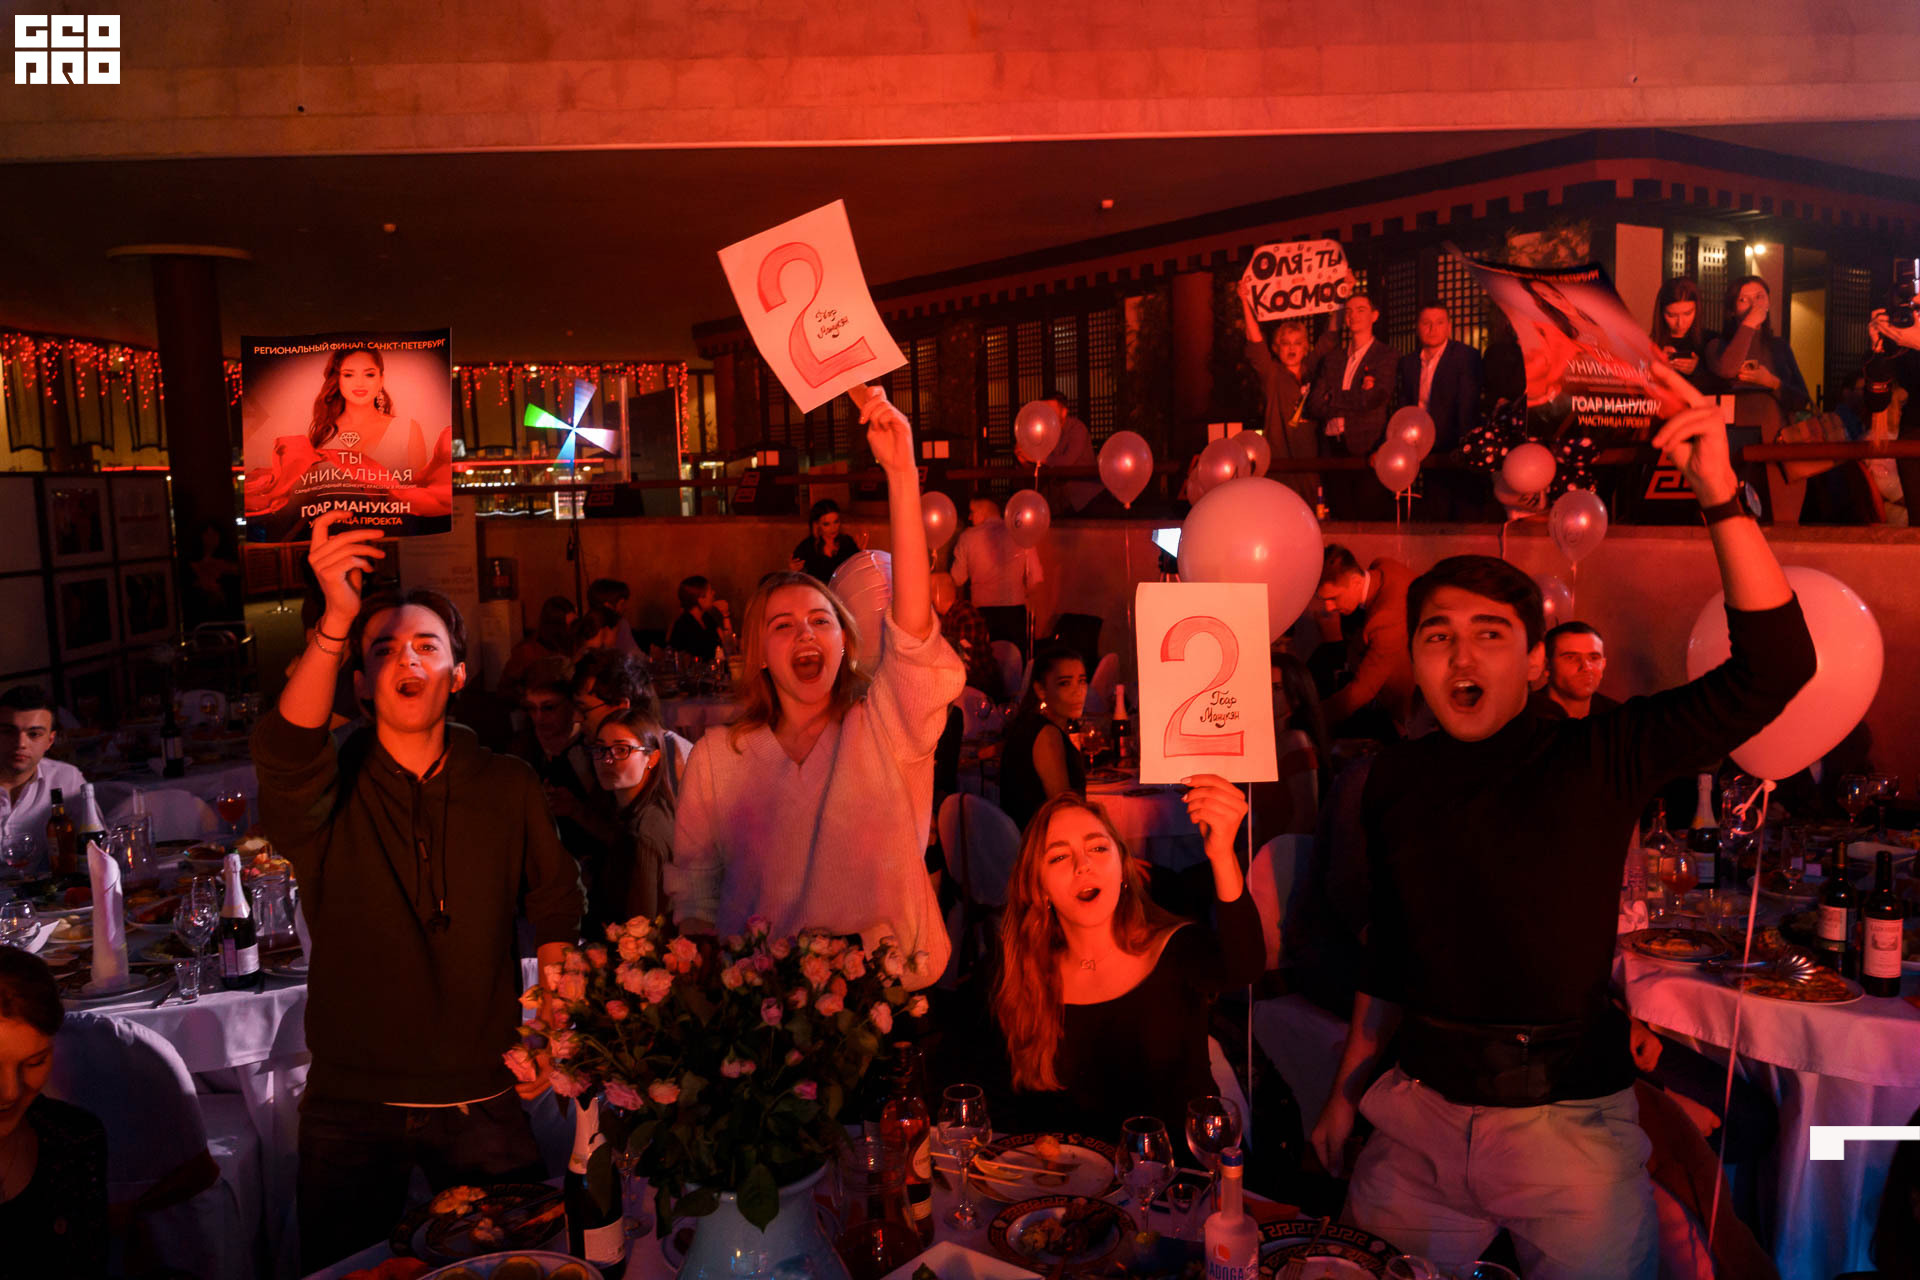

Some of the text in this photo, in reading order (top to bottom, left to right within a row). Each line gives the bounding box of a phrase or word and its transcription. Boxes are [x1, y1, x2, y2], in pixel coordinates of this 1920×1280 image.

[757, 242, 877, 389] 2
[253, 342, 329, 355] РЕГИОНАЛЬНЫЙ
[367, 338, 446, 351] САНКТ-ПЕТЕРБУРГ
[1571, 395, 1603, 412] ГОАР
[338, 451, 362, 465] ТЫ
[300, 468, 413, 486] УНИКАЛЬНАЯ
[301, 500, 411, 518] ГОАР МАНУКЯН
[360, 516, 403, 526] ПРОЕКТА
[1160, 615, 1245, 758] 2
